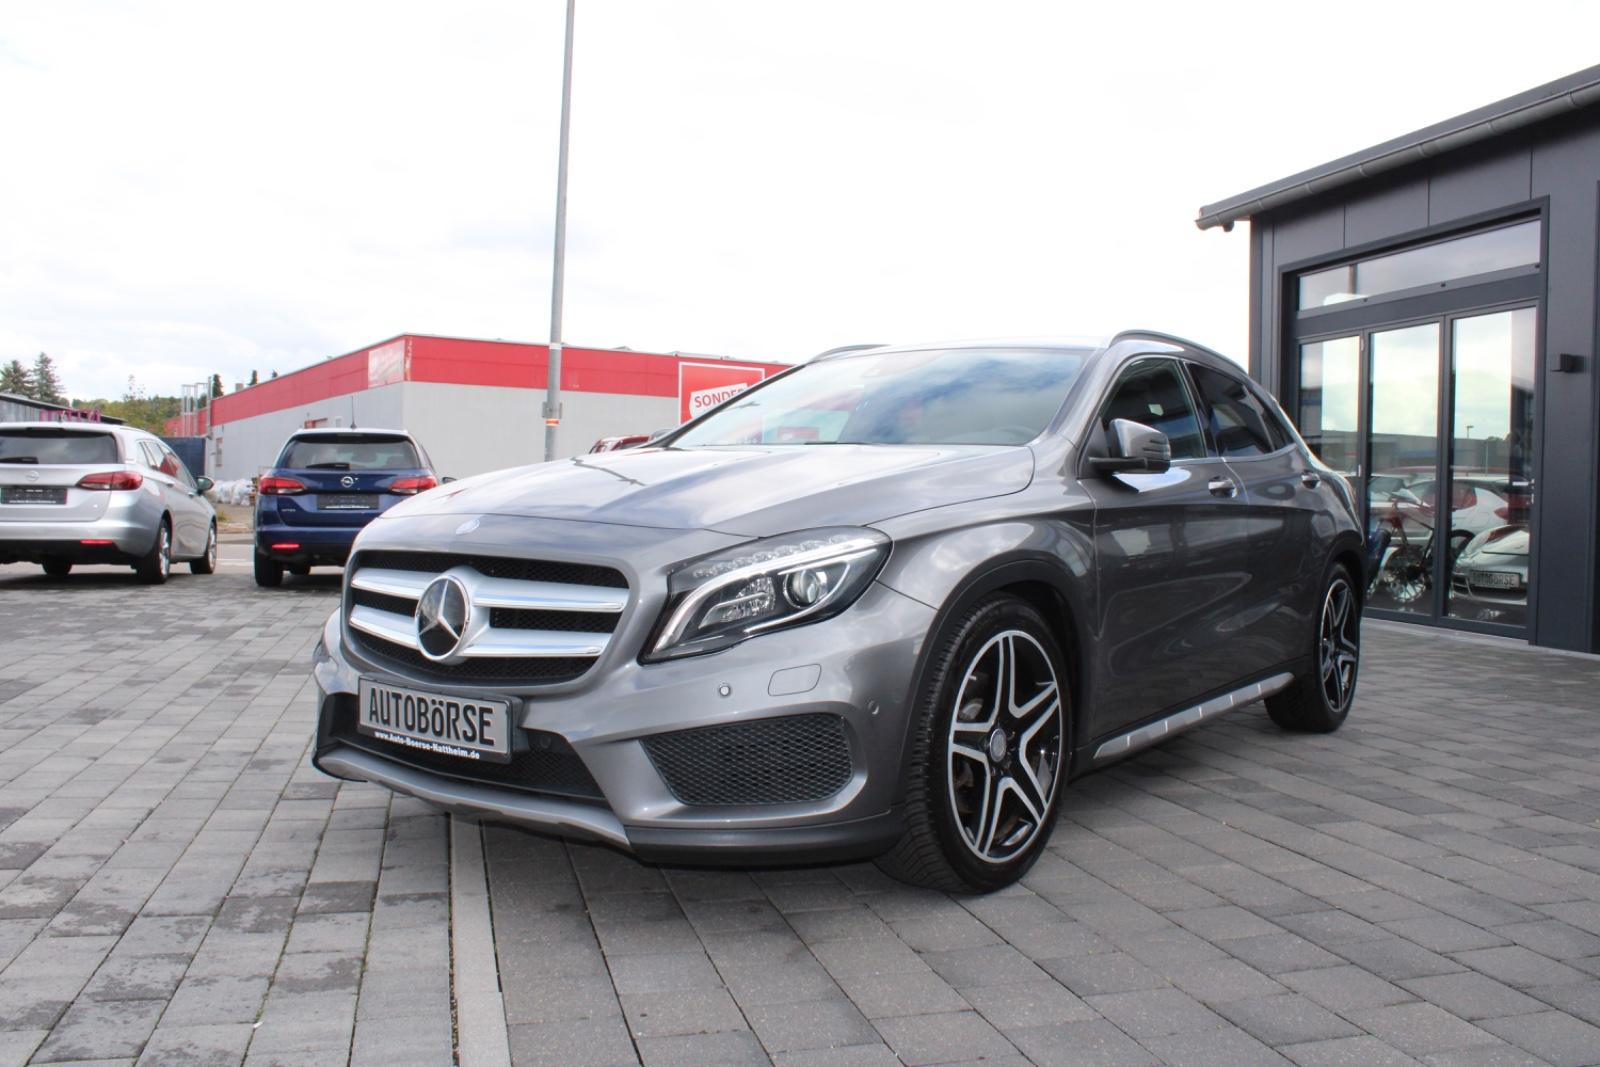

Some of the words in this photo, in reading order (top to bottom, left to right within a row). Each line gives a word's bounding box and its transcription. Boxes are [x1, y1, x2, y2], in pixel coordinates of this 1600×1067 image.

[694, 388, 744, 408] SONDE
[369, 687, 495, 746] AUTOBÖRSE
[374, 731, 480, 760] www.Auto-Boerse-Nattheim.de
